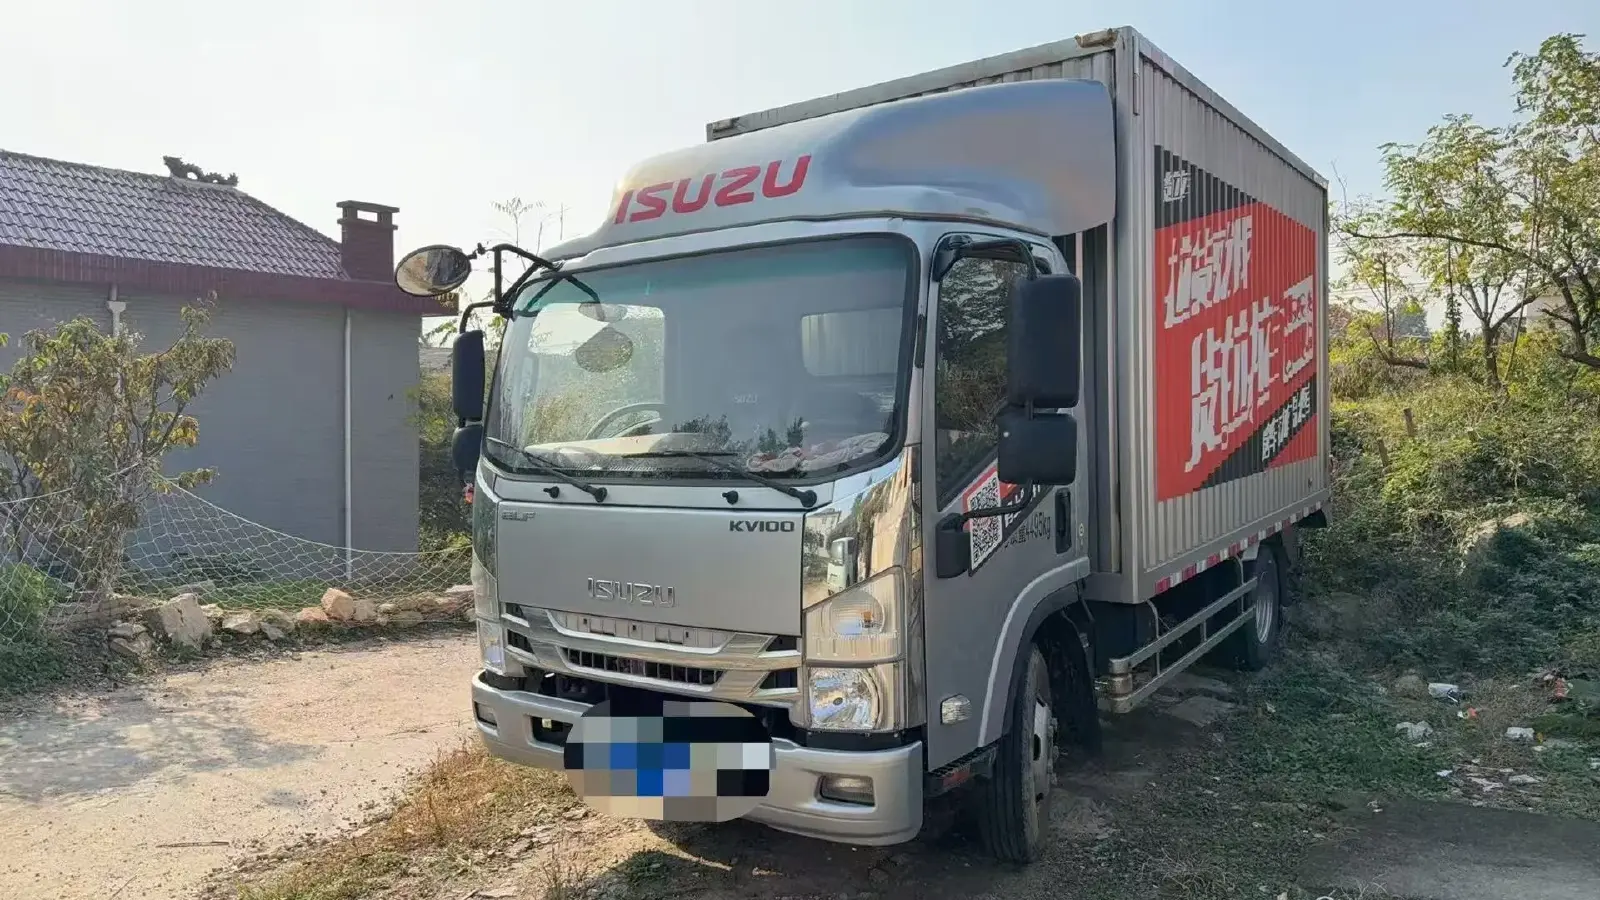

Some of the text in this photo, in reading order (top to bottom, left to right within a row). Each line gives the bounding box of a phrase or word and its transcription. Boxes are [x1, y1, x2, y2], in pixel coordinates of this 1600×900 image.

[614, 153, 812, 225] ISUZU
[731, 392, 759, 404] SUZU
[729, 520, 795, 533] KV100
[587, 576, 677, 609] ISUZU
